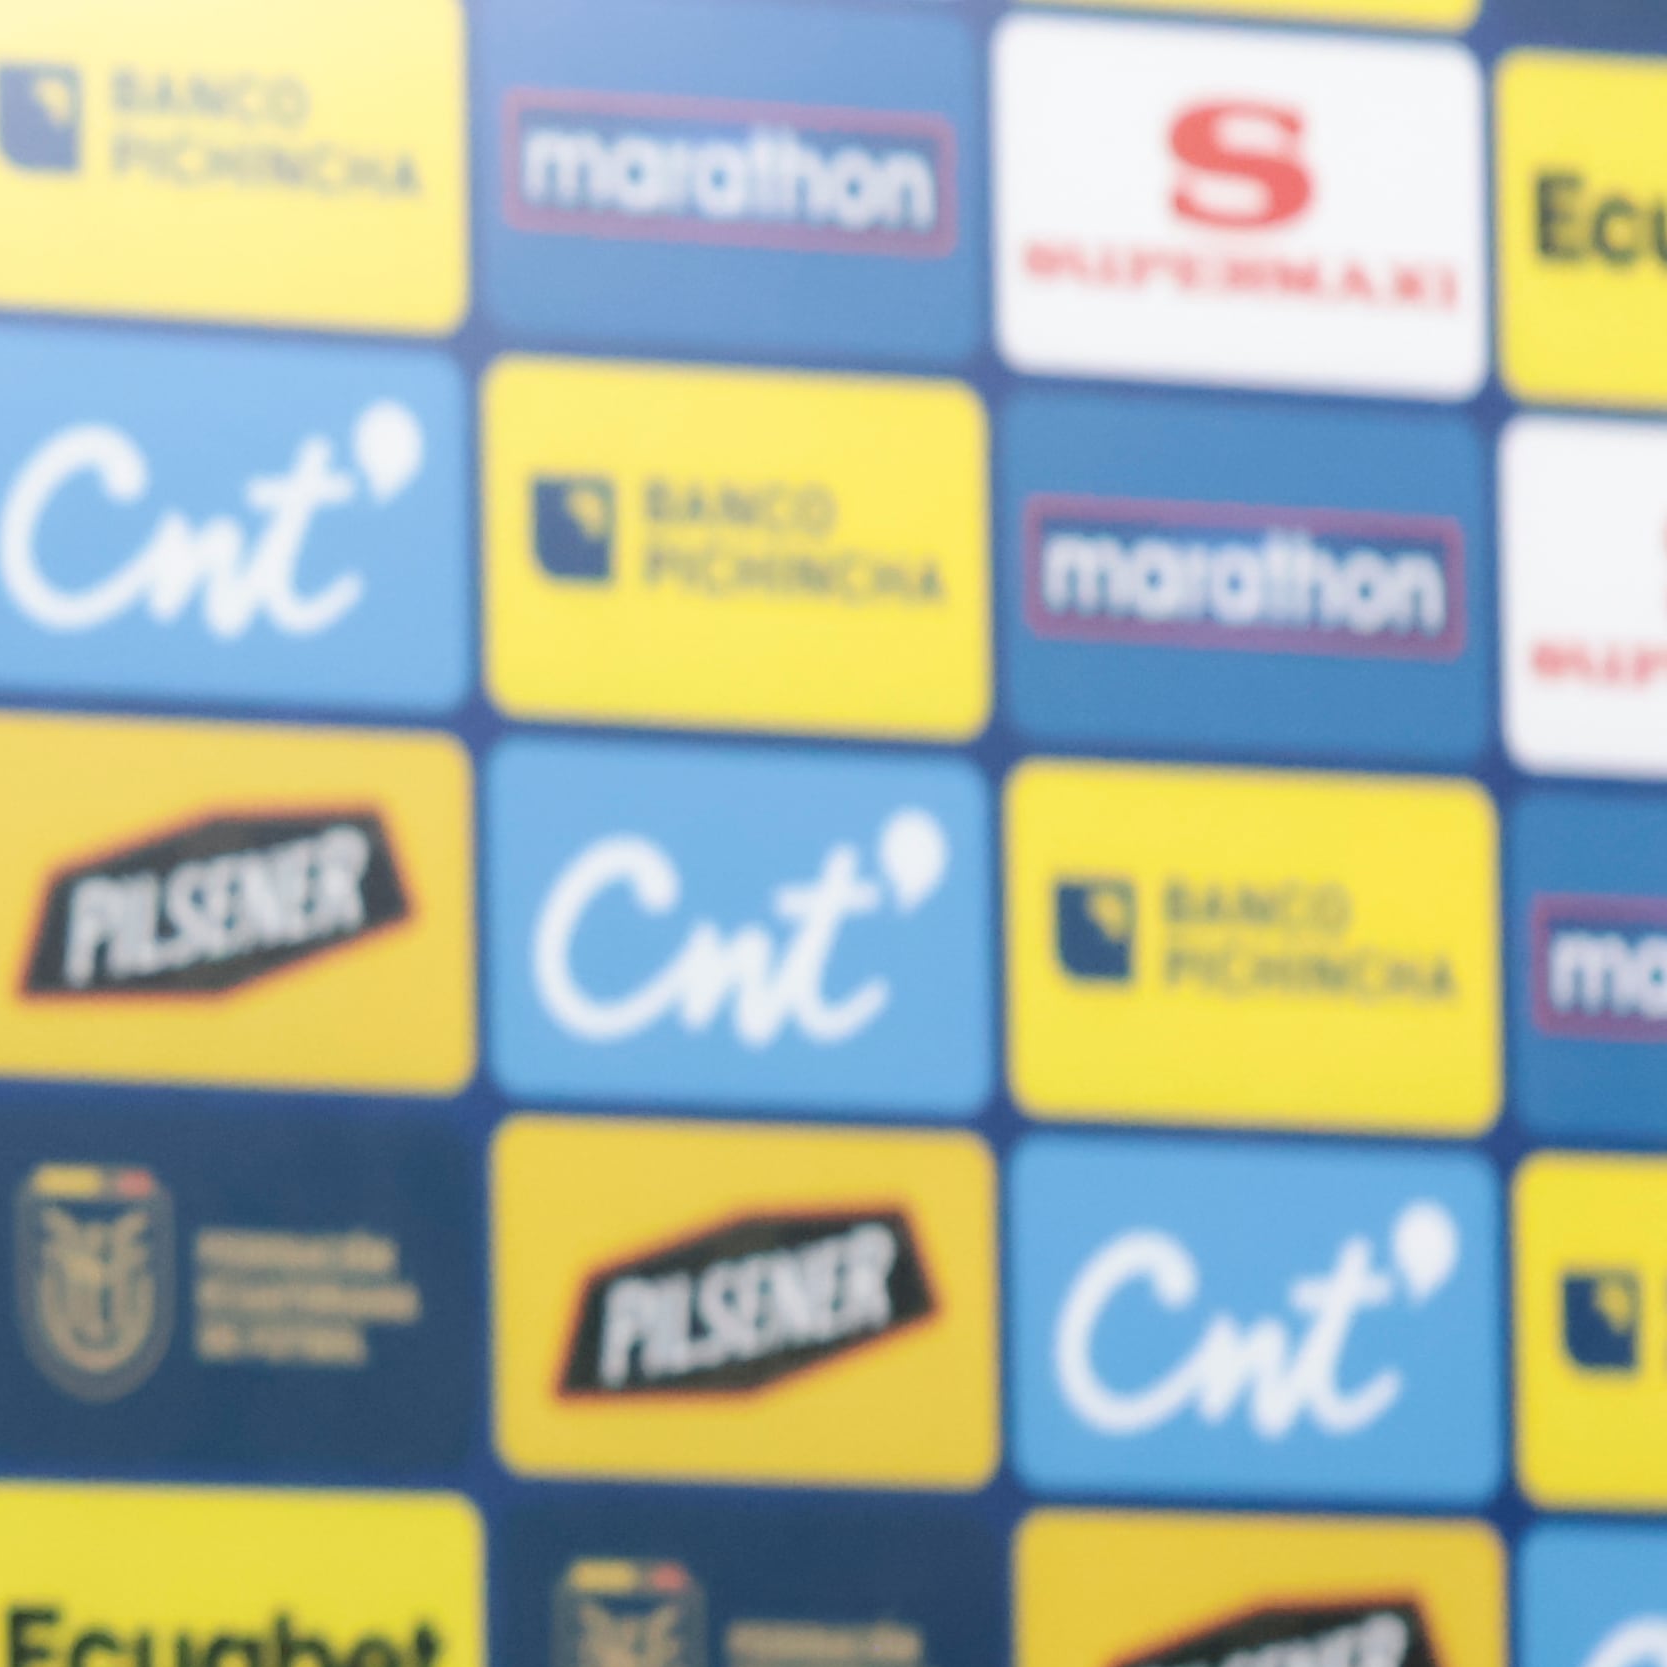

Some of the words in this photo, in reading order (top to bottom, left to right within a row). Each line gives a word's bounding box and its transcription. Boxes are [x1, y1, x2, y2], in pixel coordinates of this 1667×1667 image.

[519, 130, 934, 228] marathon
[1168, 101, 1315, 231] S
[1040, 531, 1445, 634] marathon
[66, 828, 369, 990] PILSENER
[601, 1224, 895, 1390] PILSENER
